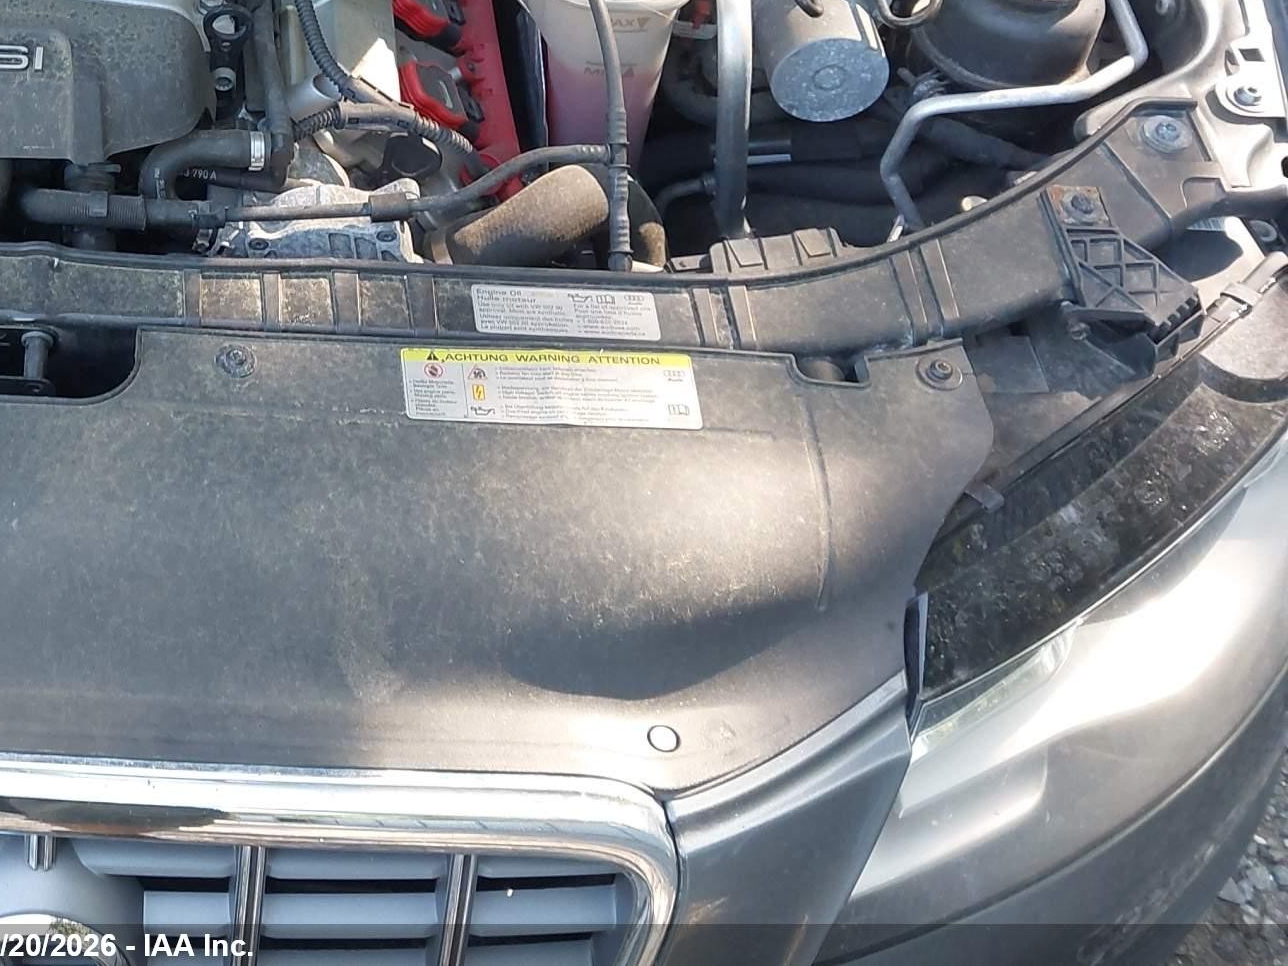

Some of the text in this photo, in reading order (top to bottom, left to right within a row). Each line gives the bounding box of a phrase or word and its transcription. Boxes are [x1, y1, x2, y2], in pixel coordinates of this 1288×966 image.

[445, 353, 661, 365] ACHTUNG WARNING ATTENTION
